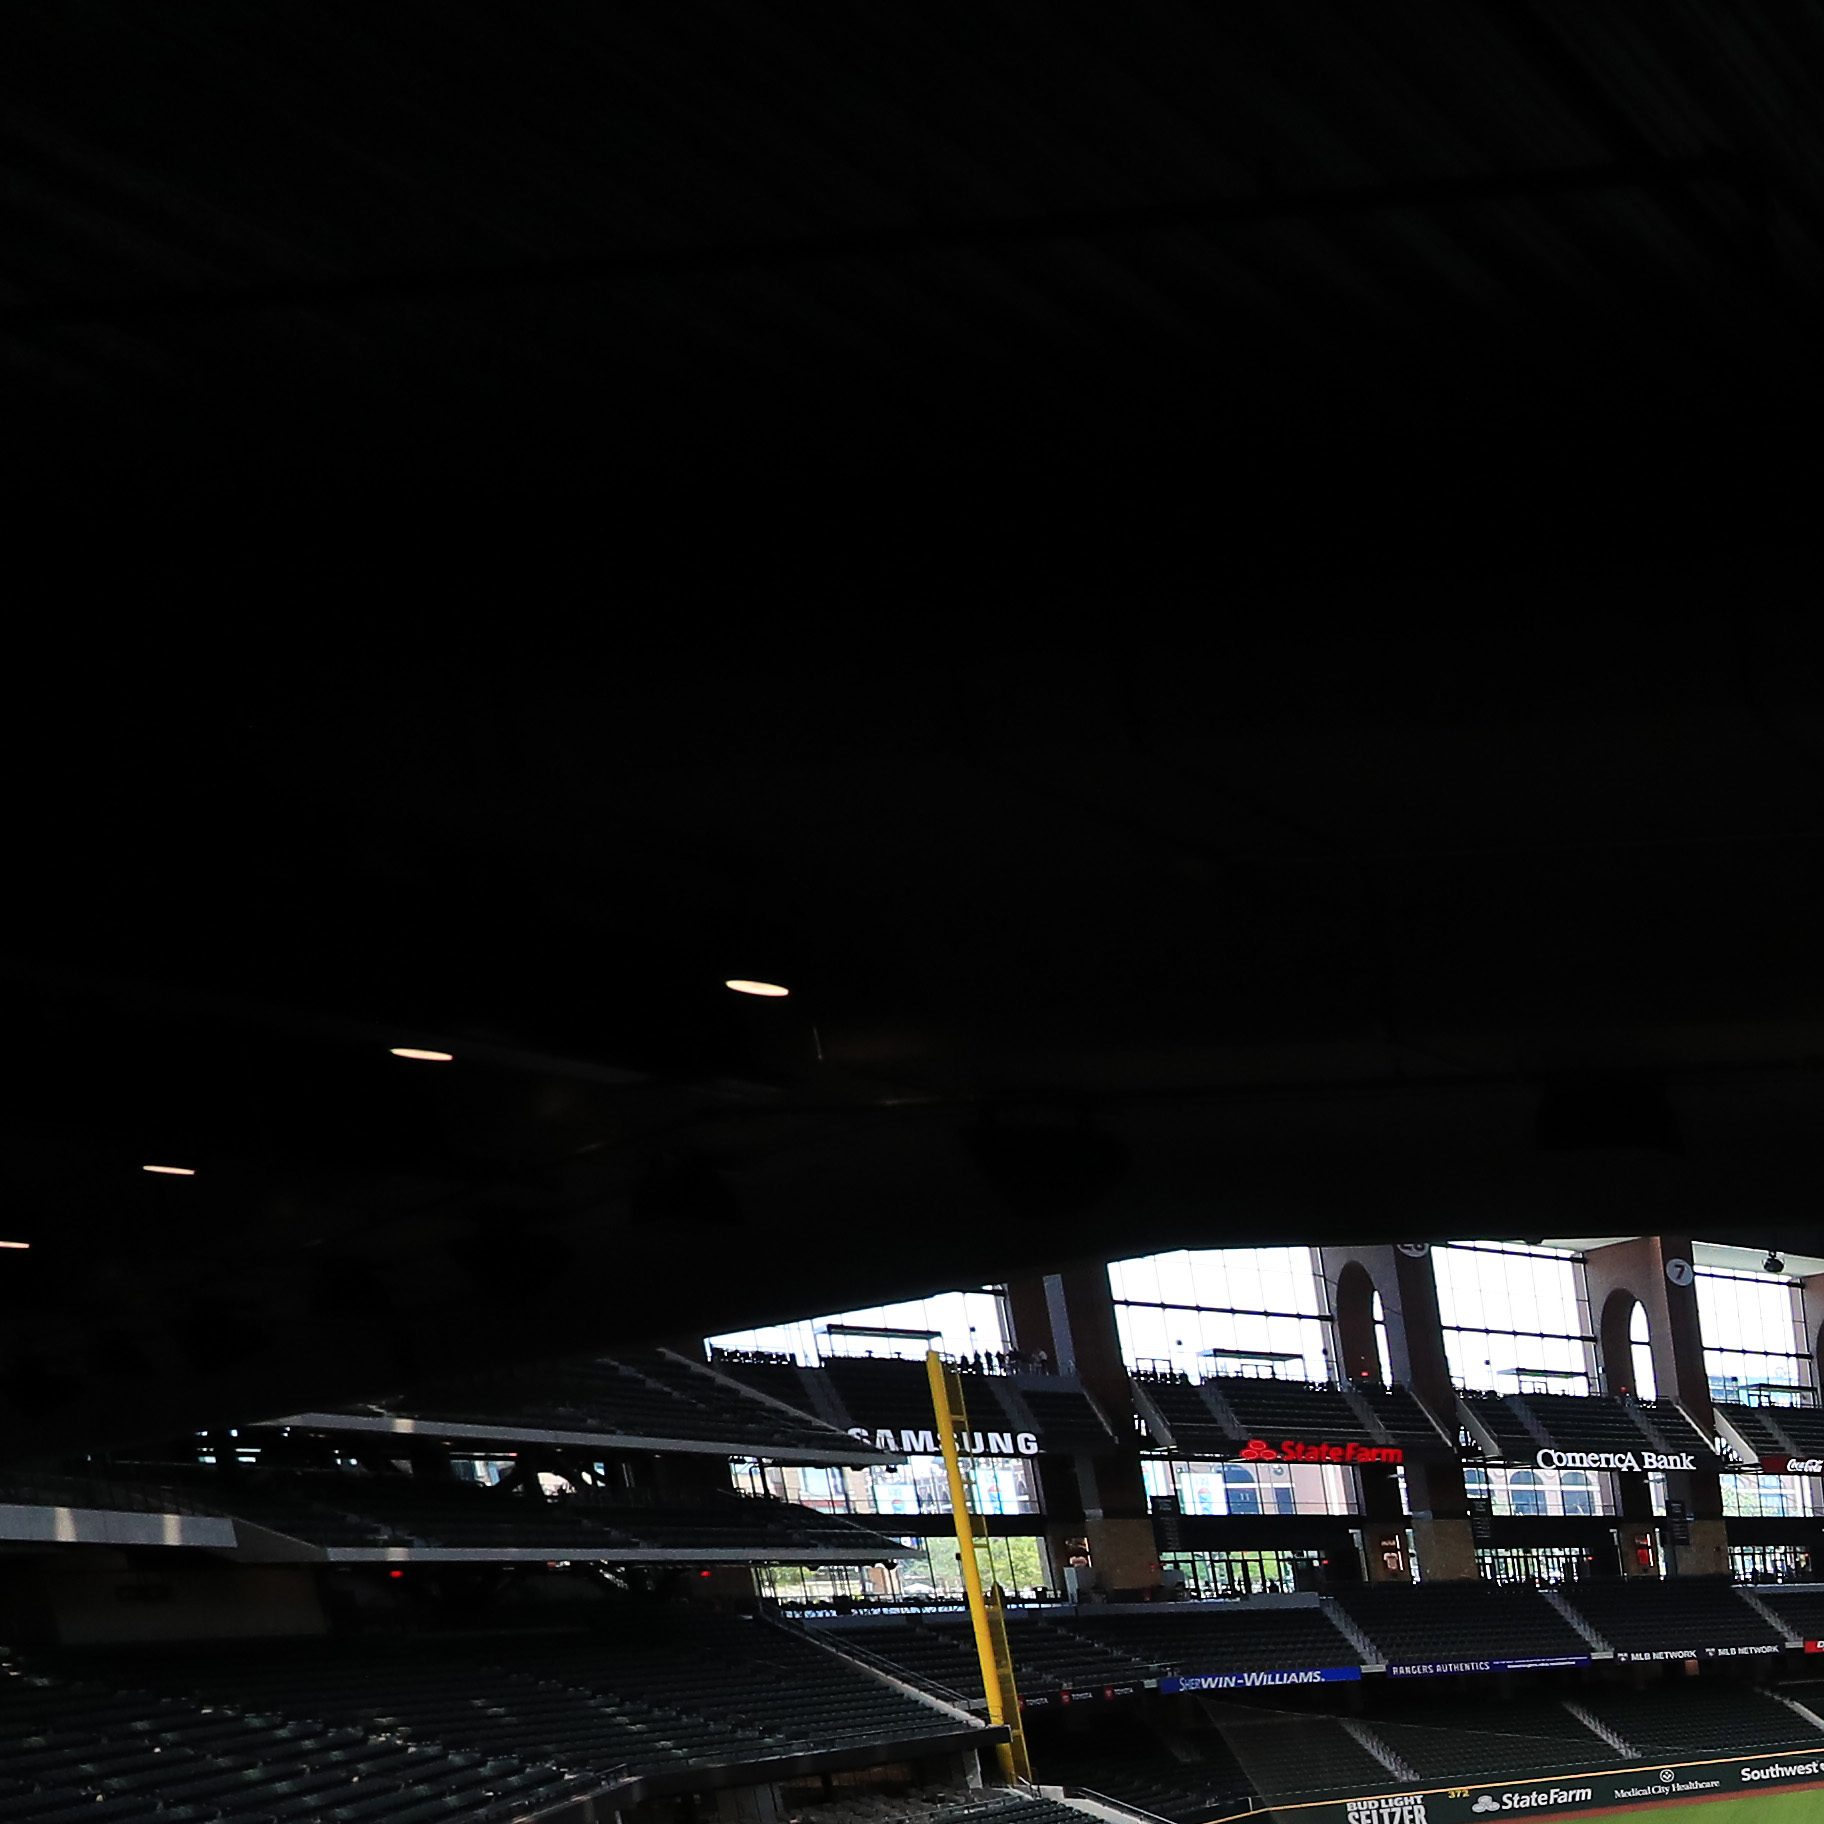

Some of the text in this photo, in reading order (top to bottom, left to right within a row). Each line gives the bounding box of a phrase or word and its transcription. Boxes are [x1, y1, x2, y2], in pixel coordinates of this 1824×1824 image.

[1641, 1452, 1697, 1470] Bank
[1631, 1650, 1698, 1661] MLB NETWORK
[1718, 1645, 1779, 1656] MLB NETWORK
[1392, 1661, 1490, 1675] RANGERS AUTHENTICS
[1740, 1761, 1818, 1781] Southwest
[1448, 1789, 1470, 1798] 372
[1614, 1779, 1720, 1799] Medical City Healthcare
[1346, 1795, 1424, 1812] BUD LIGHT
